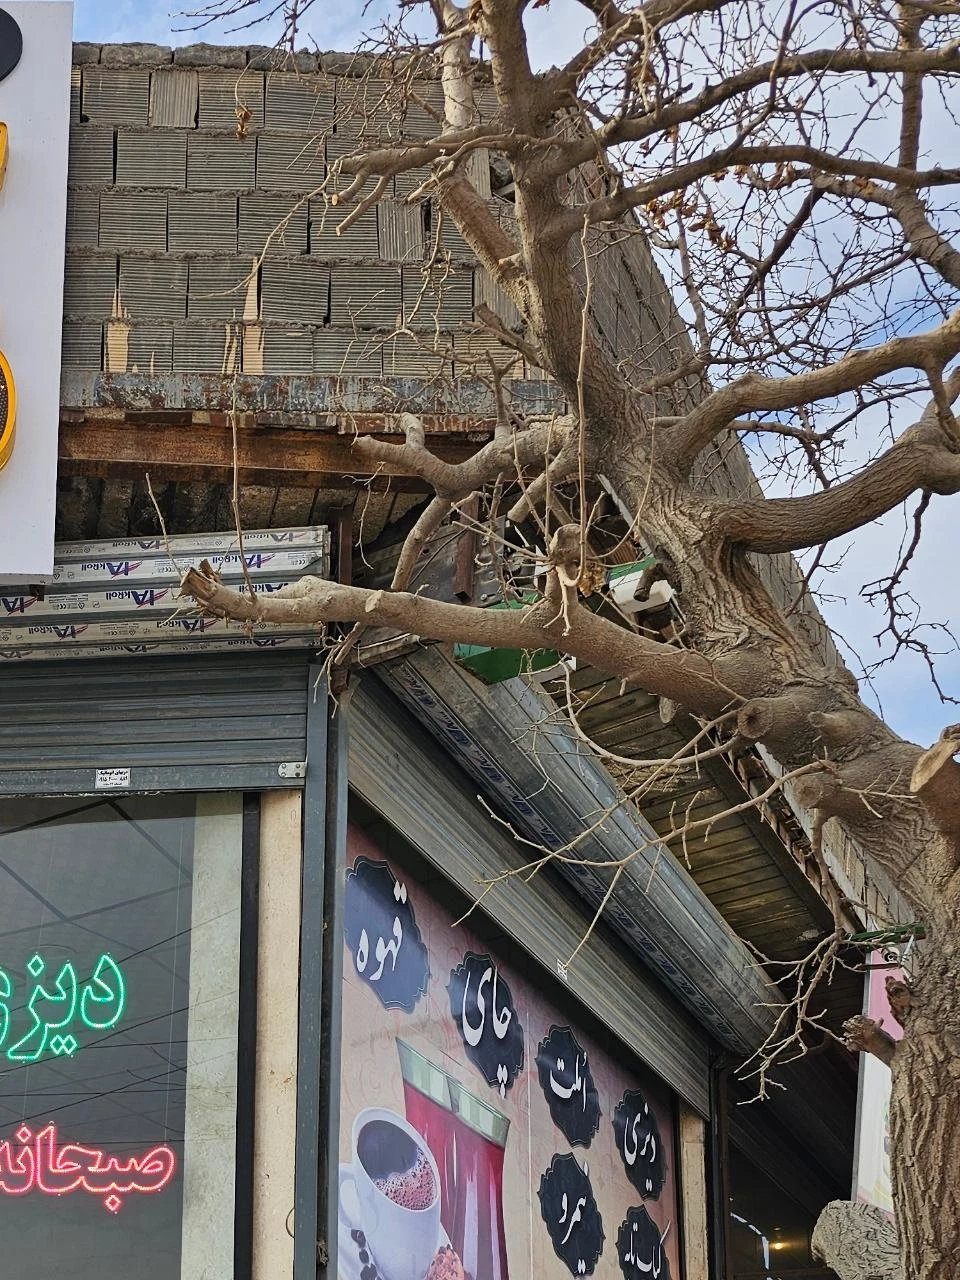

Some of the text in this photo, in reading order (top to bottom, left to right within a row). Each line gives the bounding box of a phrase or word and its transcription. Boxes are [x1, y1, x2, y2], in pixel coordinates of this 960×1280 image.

[356, 879, 407, 981] قهوه
[461, 965, 512, 1098] چای
[623, 1101, 657, 1192] دیزی
[558, 1160, 591, 1274] نیمرو
